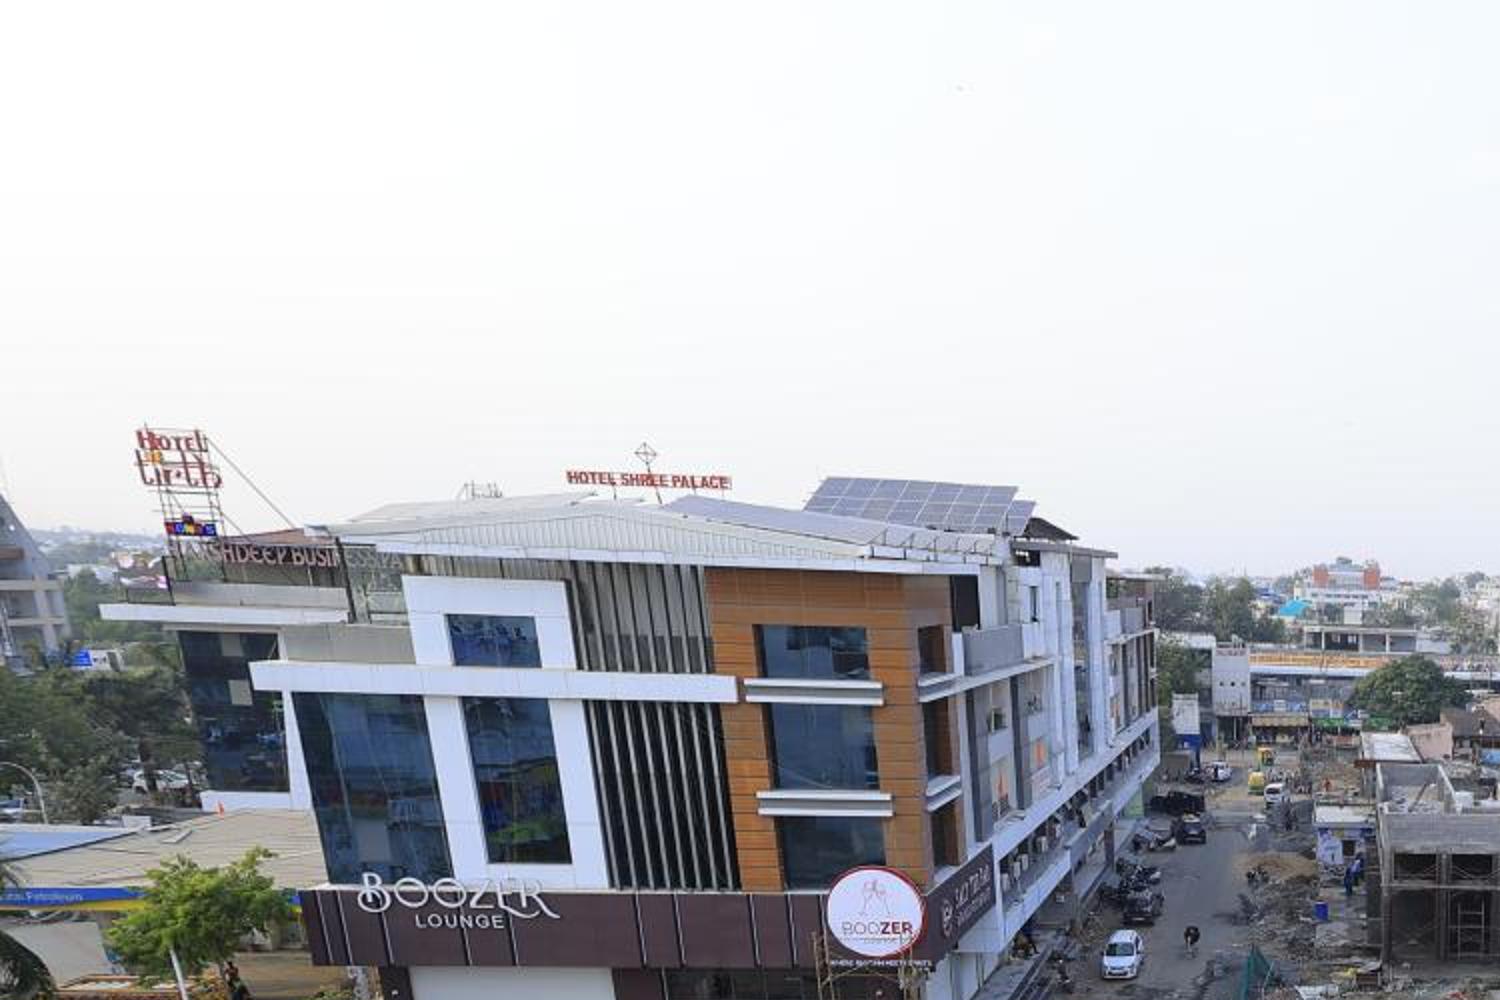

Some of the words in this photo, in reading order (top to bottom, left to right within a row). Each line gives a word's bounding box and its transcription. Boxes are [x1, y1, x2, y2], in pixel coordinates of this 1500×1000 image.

[566, 471, 616, 485] HOTEL
[621, 472, 669, 487] SHREE
[671, 475, 727, 489] PALACE
[358, 872, 560, 918] BOOZER
[416, 913, 505, 929] LOUNGE
[842, 921, 914, 935] BOOZER
